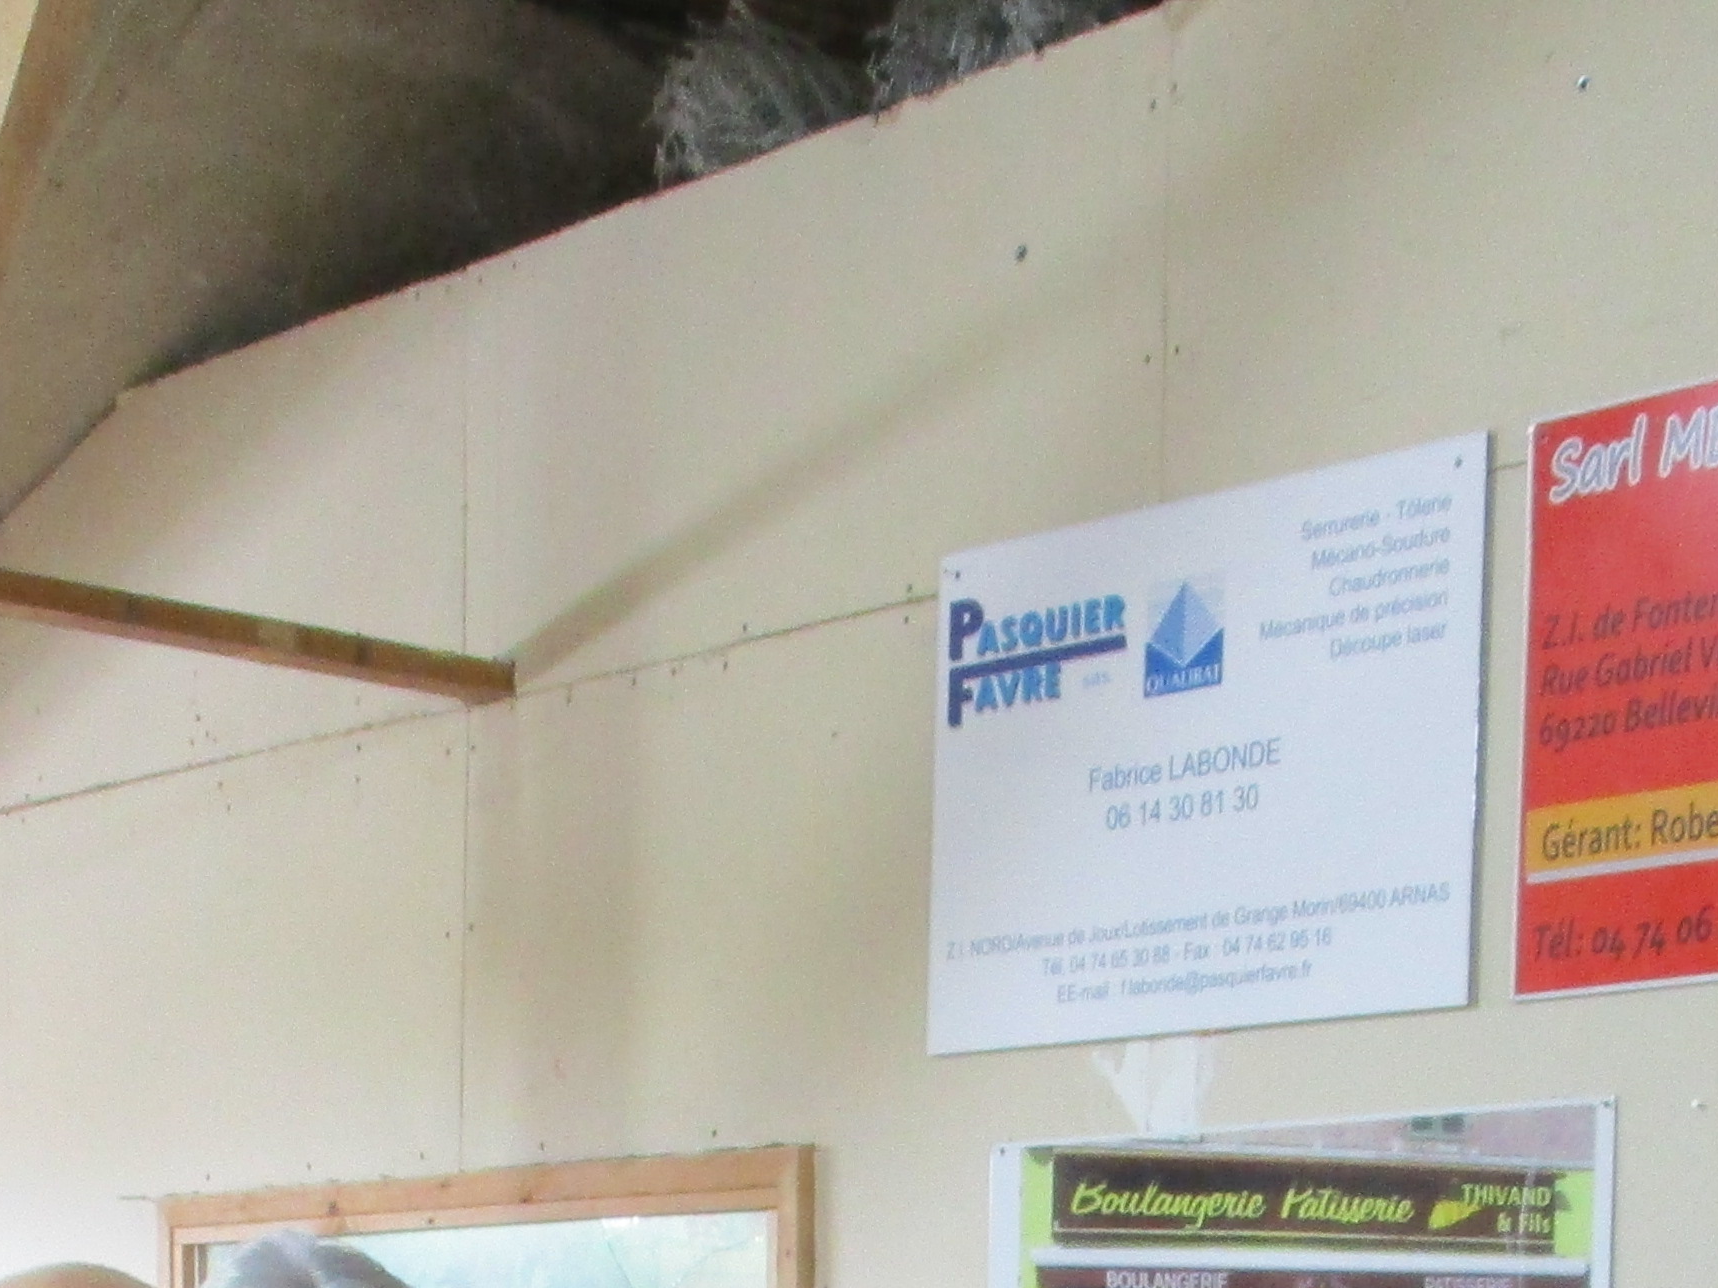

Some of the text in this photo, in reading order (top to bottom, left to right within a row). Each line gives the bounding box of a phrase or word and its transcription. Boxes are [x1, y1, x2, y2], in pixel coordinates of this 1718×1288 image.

[1549, 411, 1647, 505] Sarl
[1593, 602, 1626, 640] de
[1543, 663, 1590, 695] Rue
[1597, 641, 1693, 688] Gabriel
[1539, 709, 1617, 753] 69220
[1089, 736, 1282, 792] Fabrice LABONDE
[1106, 782, 1259, 830] 06 14 30 81 30
[1542, 817, 1641, 861] Gérant:
[1534, 917, 1582, 962] Tél:
[1591, 925, 1625, 960] 04
[1633, 919, 1667, 959] 74
[1676, 904, 1714, 944] 06
[1069, 1179, 1267, 1230] Boulangerie
